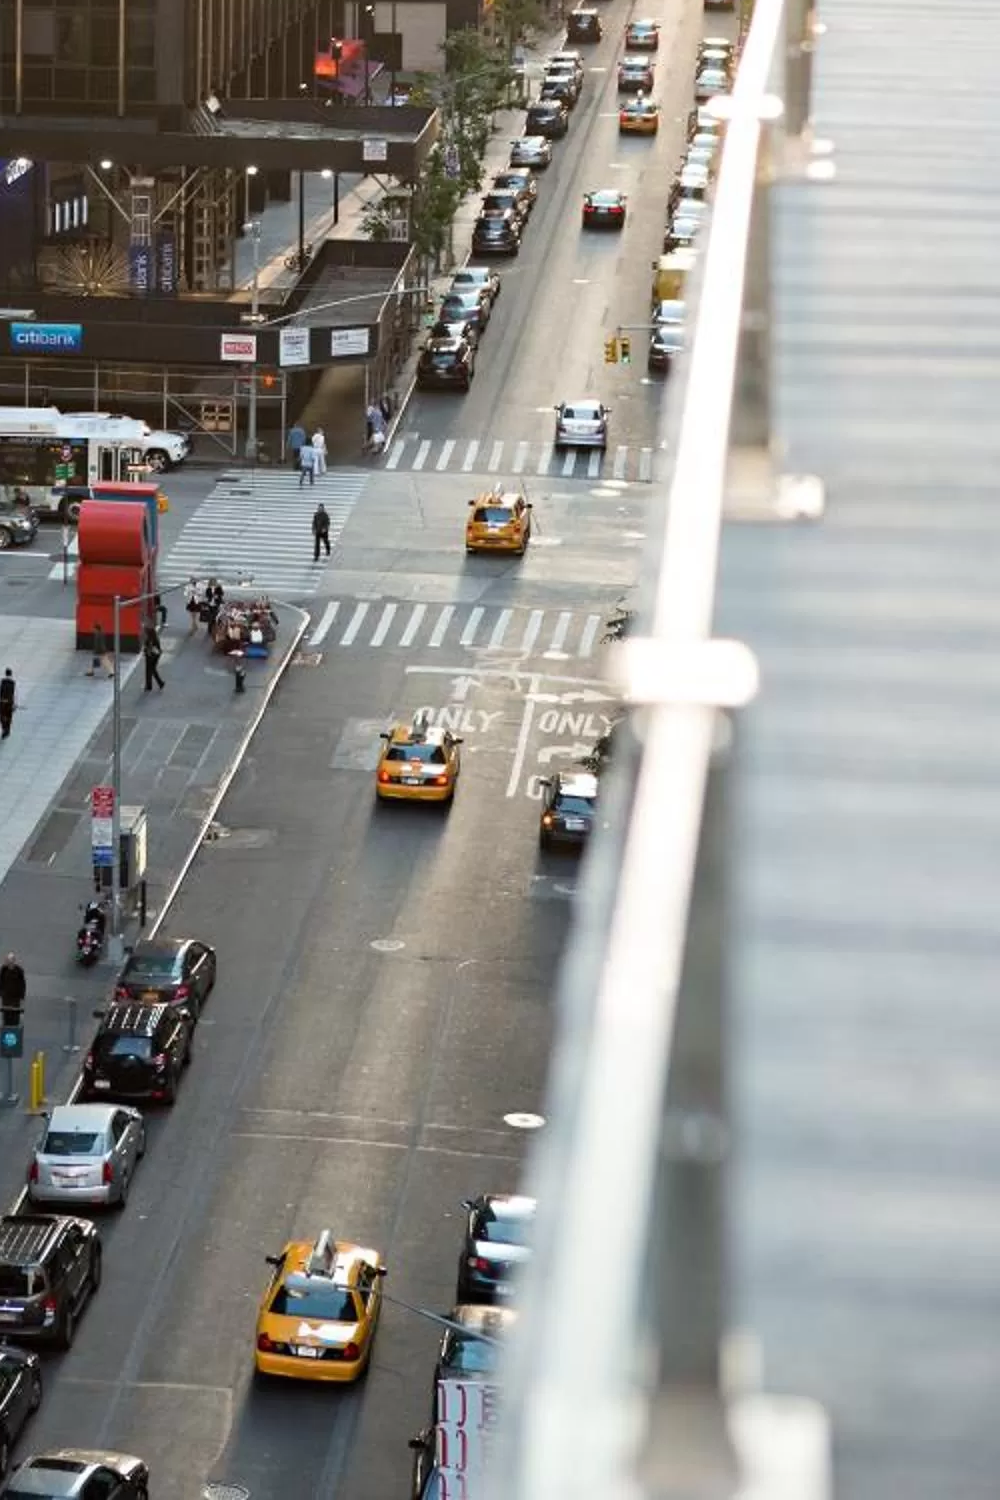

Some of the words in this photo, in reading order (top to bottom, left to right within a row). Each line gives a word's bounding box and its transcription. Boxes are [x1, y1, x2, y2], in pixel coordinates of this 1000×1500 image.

[15, 331, 75, 346] citibank
[412, 706, 505, 733] ONLY
[538, 710, 628, 738] ONLY
